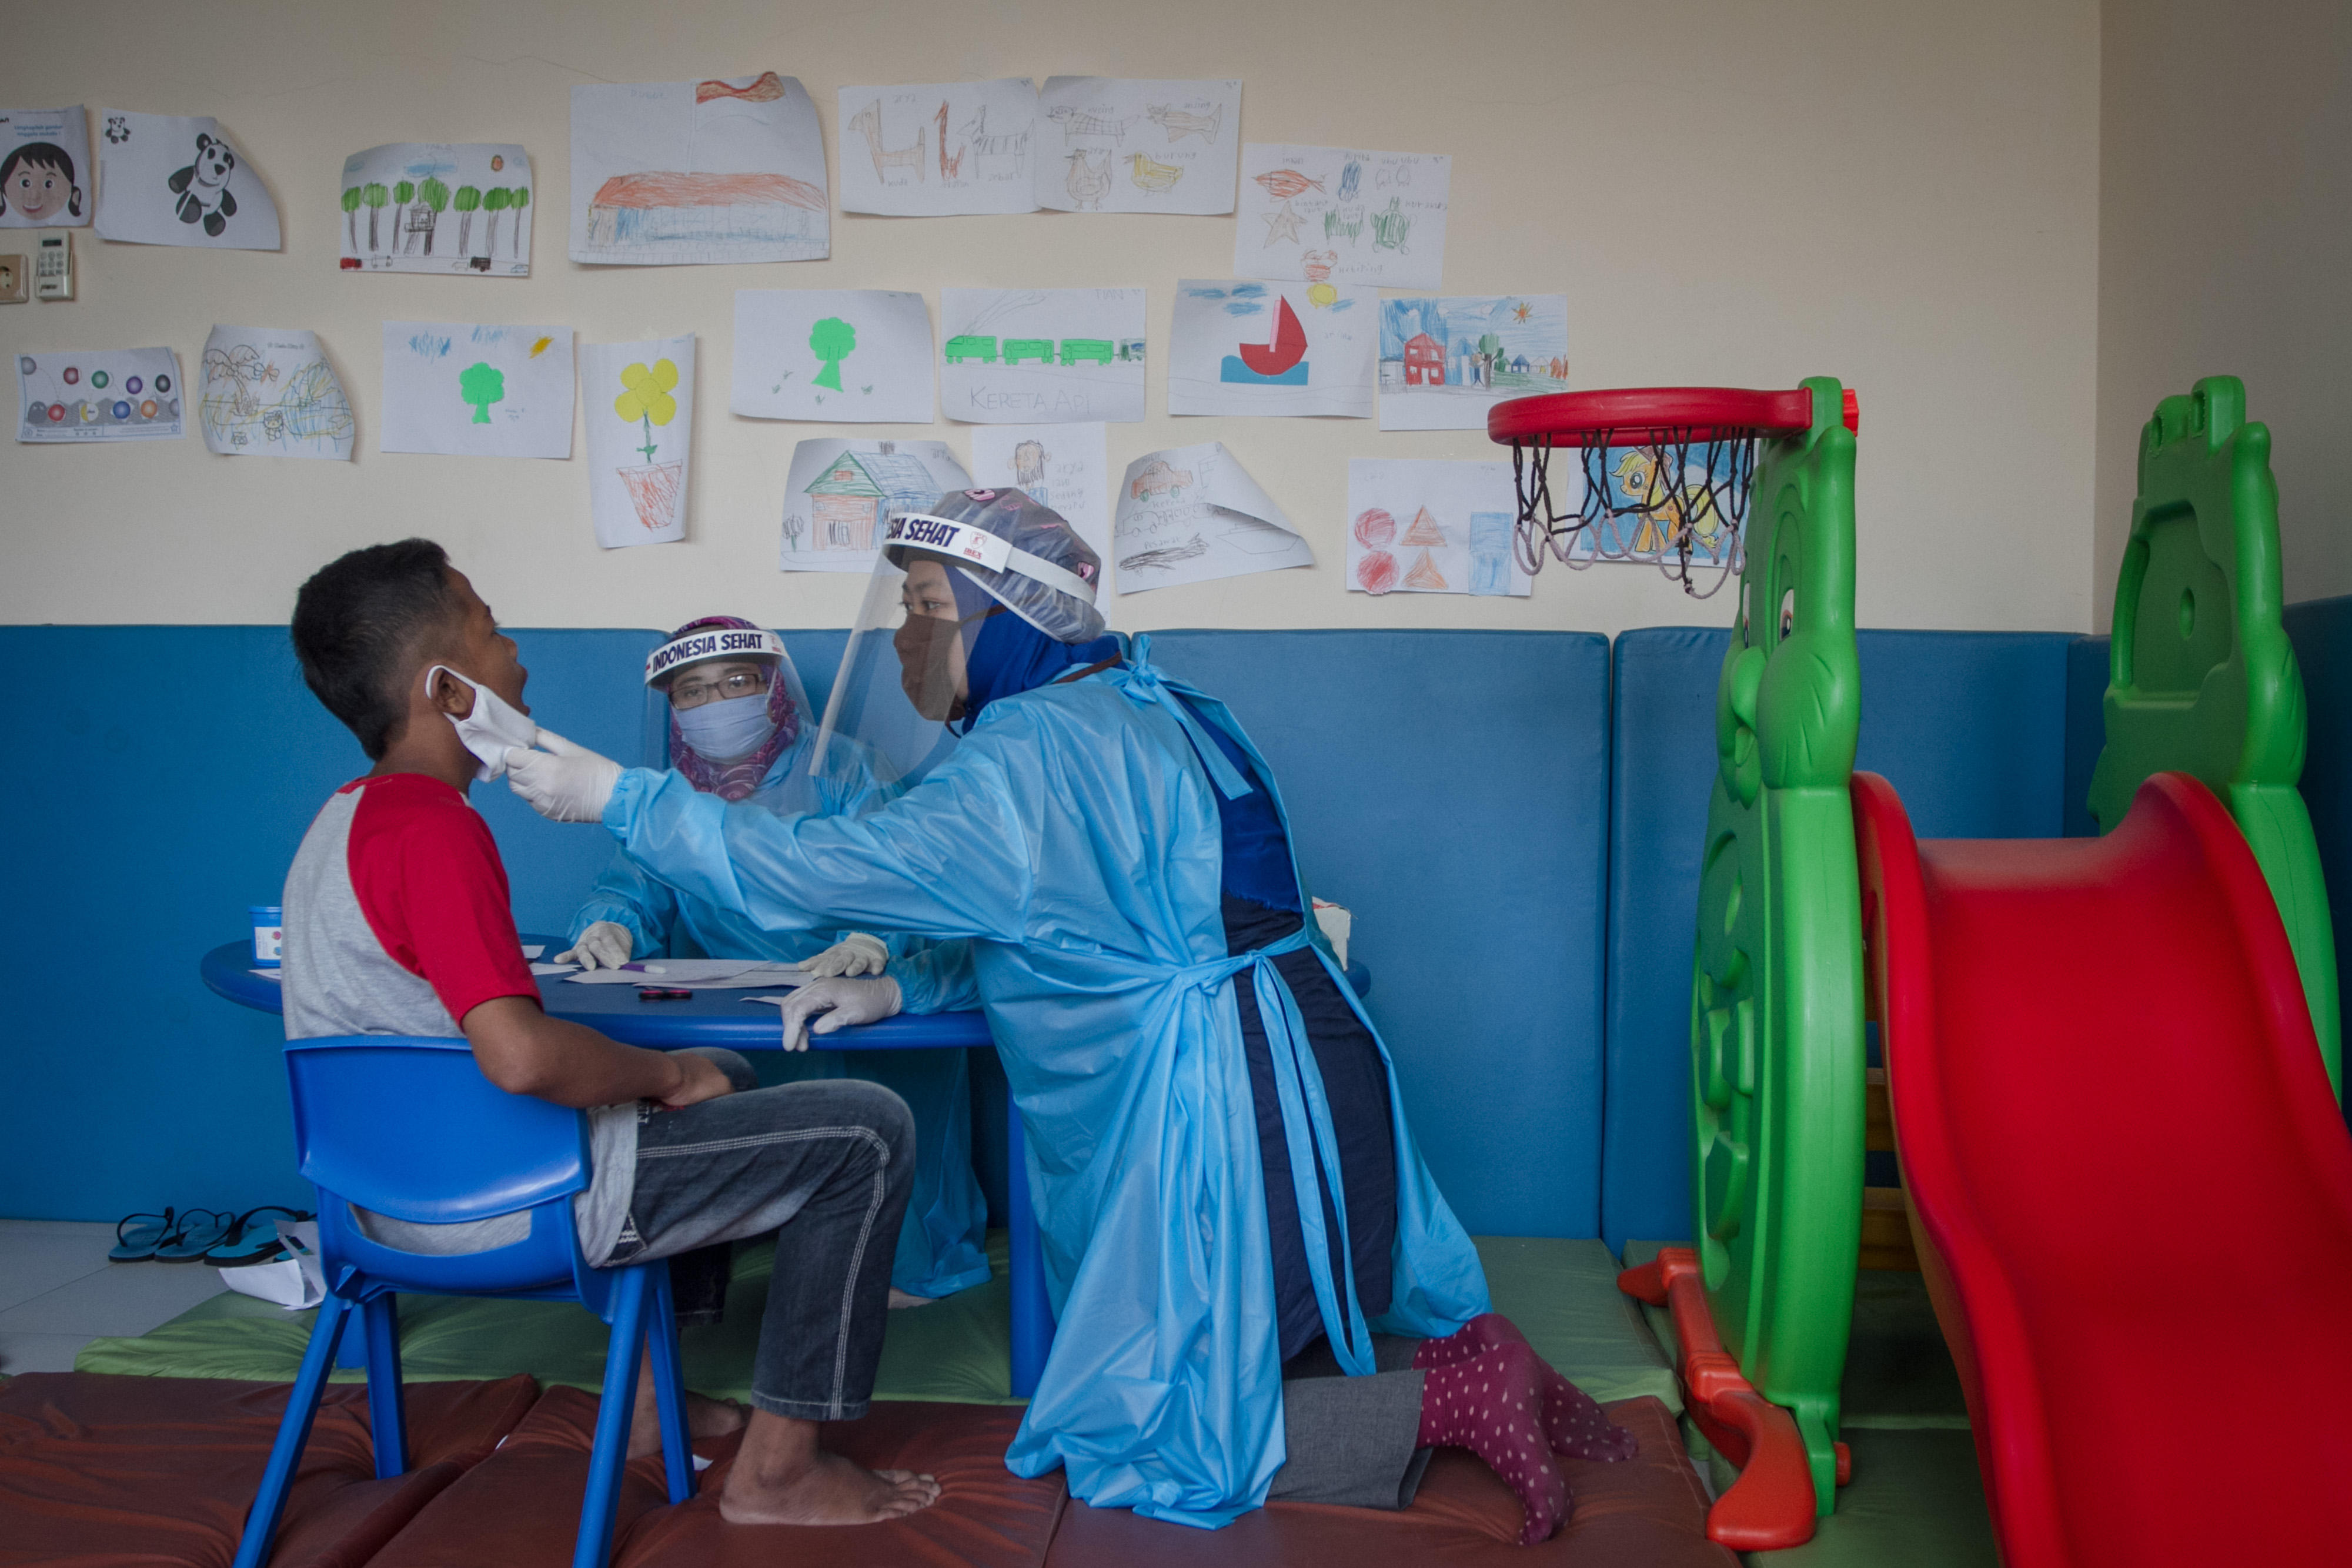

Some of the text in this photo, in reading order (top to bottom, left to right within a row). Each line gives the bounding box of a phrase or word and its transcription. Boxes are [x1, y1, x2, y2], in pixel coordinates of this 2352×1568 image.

[1095, 289, 1124, 300] TIAN
[970, 386, 1048, 410] KERETA
[904, 519, 961, 547] SEHAT
[964, 547, 982, 559] IBEX
[652, 633, 763, 674] INDONESIA SEHAT
